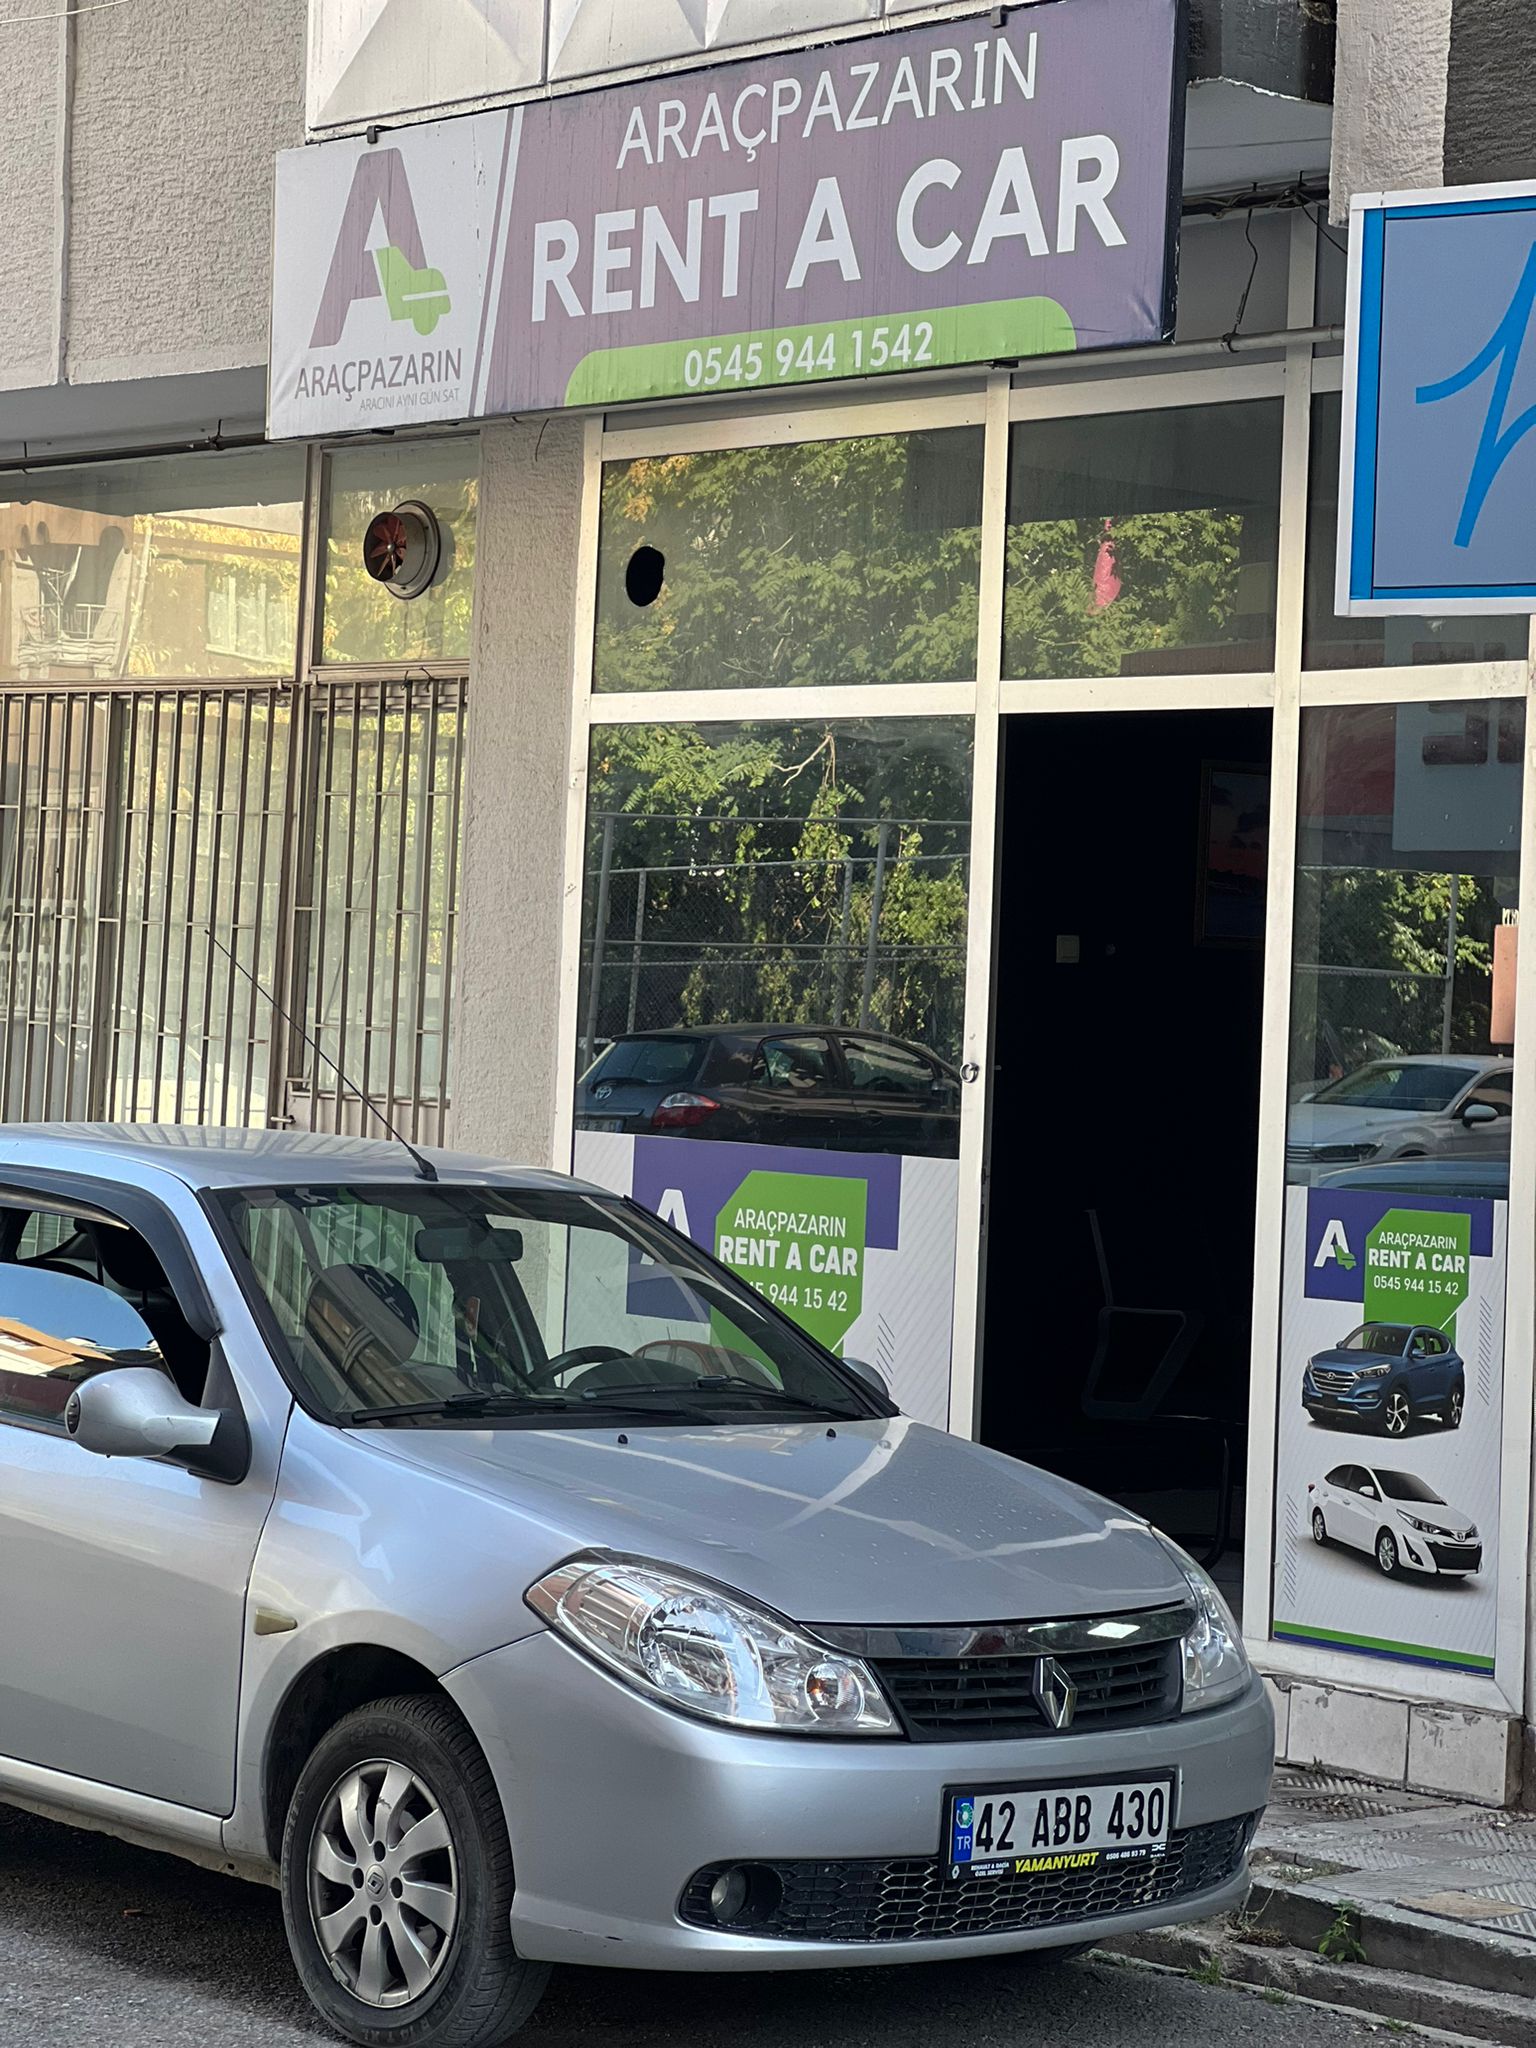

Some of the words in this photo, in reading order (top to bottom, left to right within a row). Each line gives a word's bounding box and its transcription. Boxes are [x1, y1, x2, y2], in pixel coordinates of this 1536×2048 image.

[615, 31, 1038, 169] ARAÇPAZARIN
[530, 189, 759, 322] RENT
[785, 175, 862, 289] A
[895, 133, 1127, 273] CAR
[684, 342, 763, 388] 0545
[775, 333, 836, 377] 944
[852, 321, 933, 369] 1542
[294, 347, 462, 402] ARAÇPAZARIN
[442, 387, 460, 403] SAT
[734, 1207, 847, 1239] ARAÇPAZARIN
[1378, 1231, 1458, 1250] ARAÇPAZARIN
[718, 1235, 781, 1268] RENT
[784, 1242, 803, 1271] A
[809, 1243, 858, 1277] CAR
[1368, 1248, 1412, 1269] RENT
[1415, 1253, 1427, 1271] A
[1431, 1254, 1466, 1274] CAR
[769, 1283, 798, 1307] 944
[803, 1287, 823, 1310] 15
[827, 1290, 848, 1312] 42
[1373, 1275, 1401, 1290] 0545
[1404, 1278, 1425, 1292] 944
[1428, 1280, 1442, 1294] 15
[1444, 1281, 1459, 1296] 42
[975, 1800, 1015, 1853] 42
[1032, 1794, 1092, 1848] ABB
[1107, 1787, 1164, 1840] 430
[956, 1835, 972, 1850] TR
[1014, 1851, 1100, 1874] YAMANYURT
